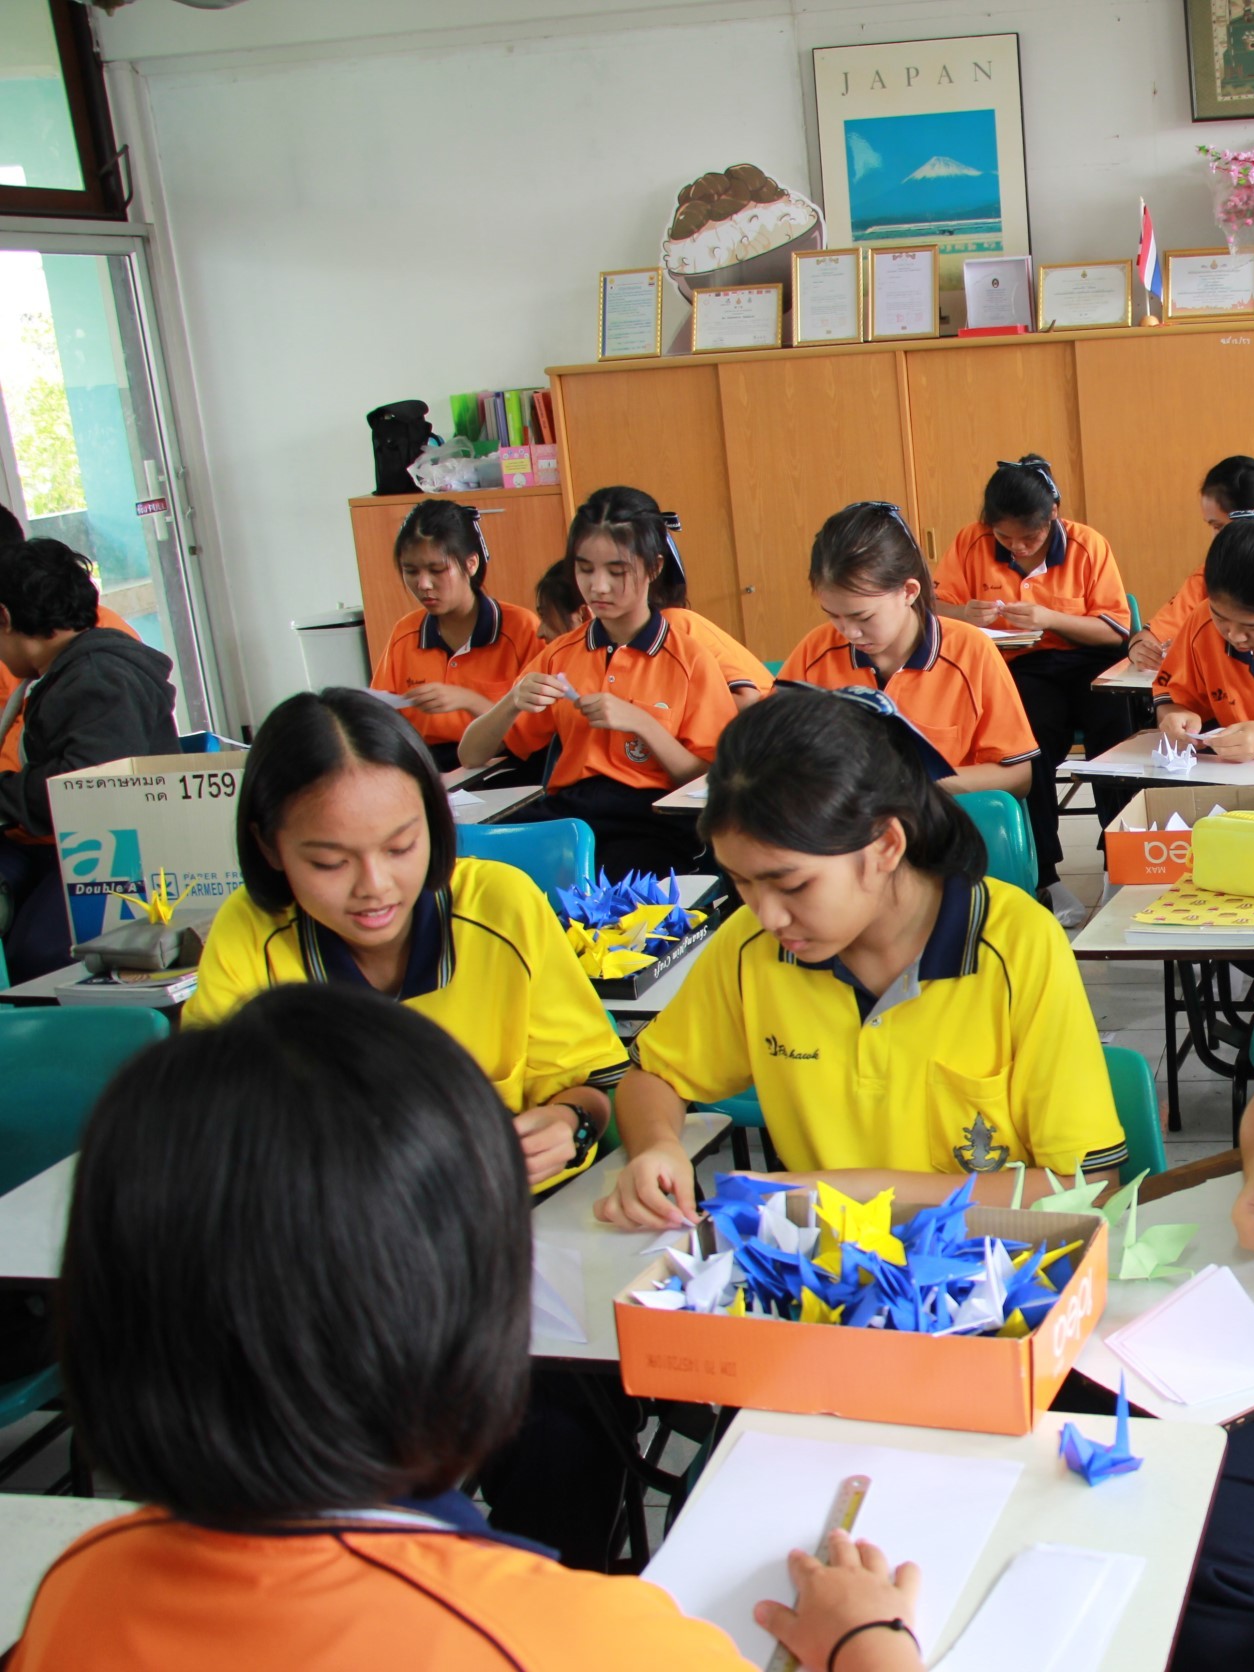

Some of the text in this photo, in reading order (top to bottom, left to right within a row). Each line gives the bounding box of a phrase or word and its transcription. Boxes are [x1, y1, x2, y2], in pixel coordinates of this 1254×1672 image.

[841, 61, 993, 96] JAPAN
[63, 772, 236, 800] กระดาษหมด 1759
[146, 791, 168, 801] กด
[1144, 840, 1192, 864] ea
[1145, 866, 1166, 874] MAX
[75, 880, 137, 895] Double A
